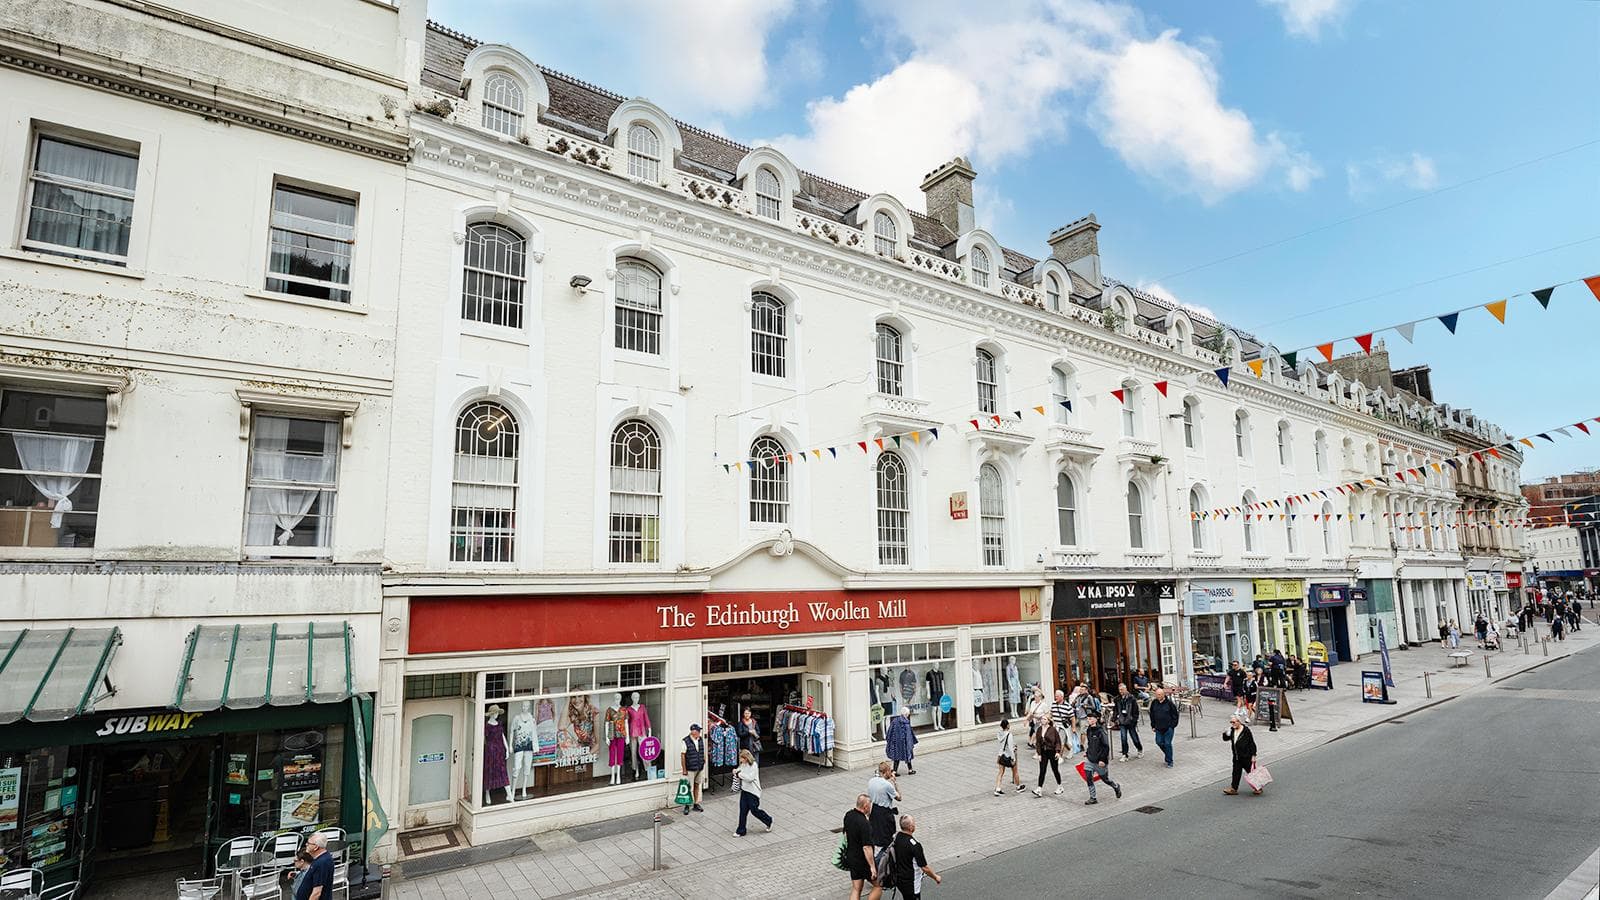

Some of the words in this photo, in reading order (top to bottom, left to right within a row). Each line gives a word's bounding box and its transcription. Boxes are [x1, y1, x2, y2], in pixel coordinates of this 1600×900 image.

[657, 605, 696, 628] The
[706, 602, 800, 629] Edinburgh
[808, 600, 870, 621] Woollen
[878, 599, 907, 618] Mill
[96, 713, 203, 737] SUBWAY
[680, 784, 689, 794] D
